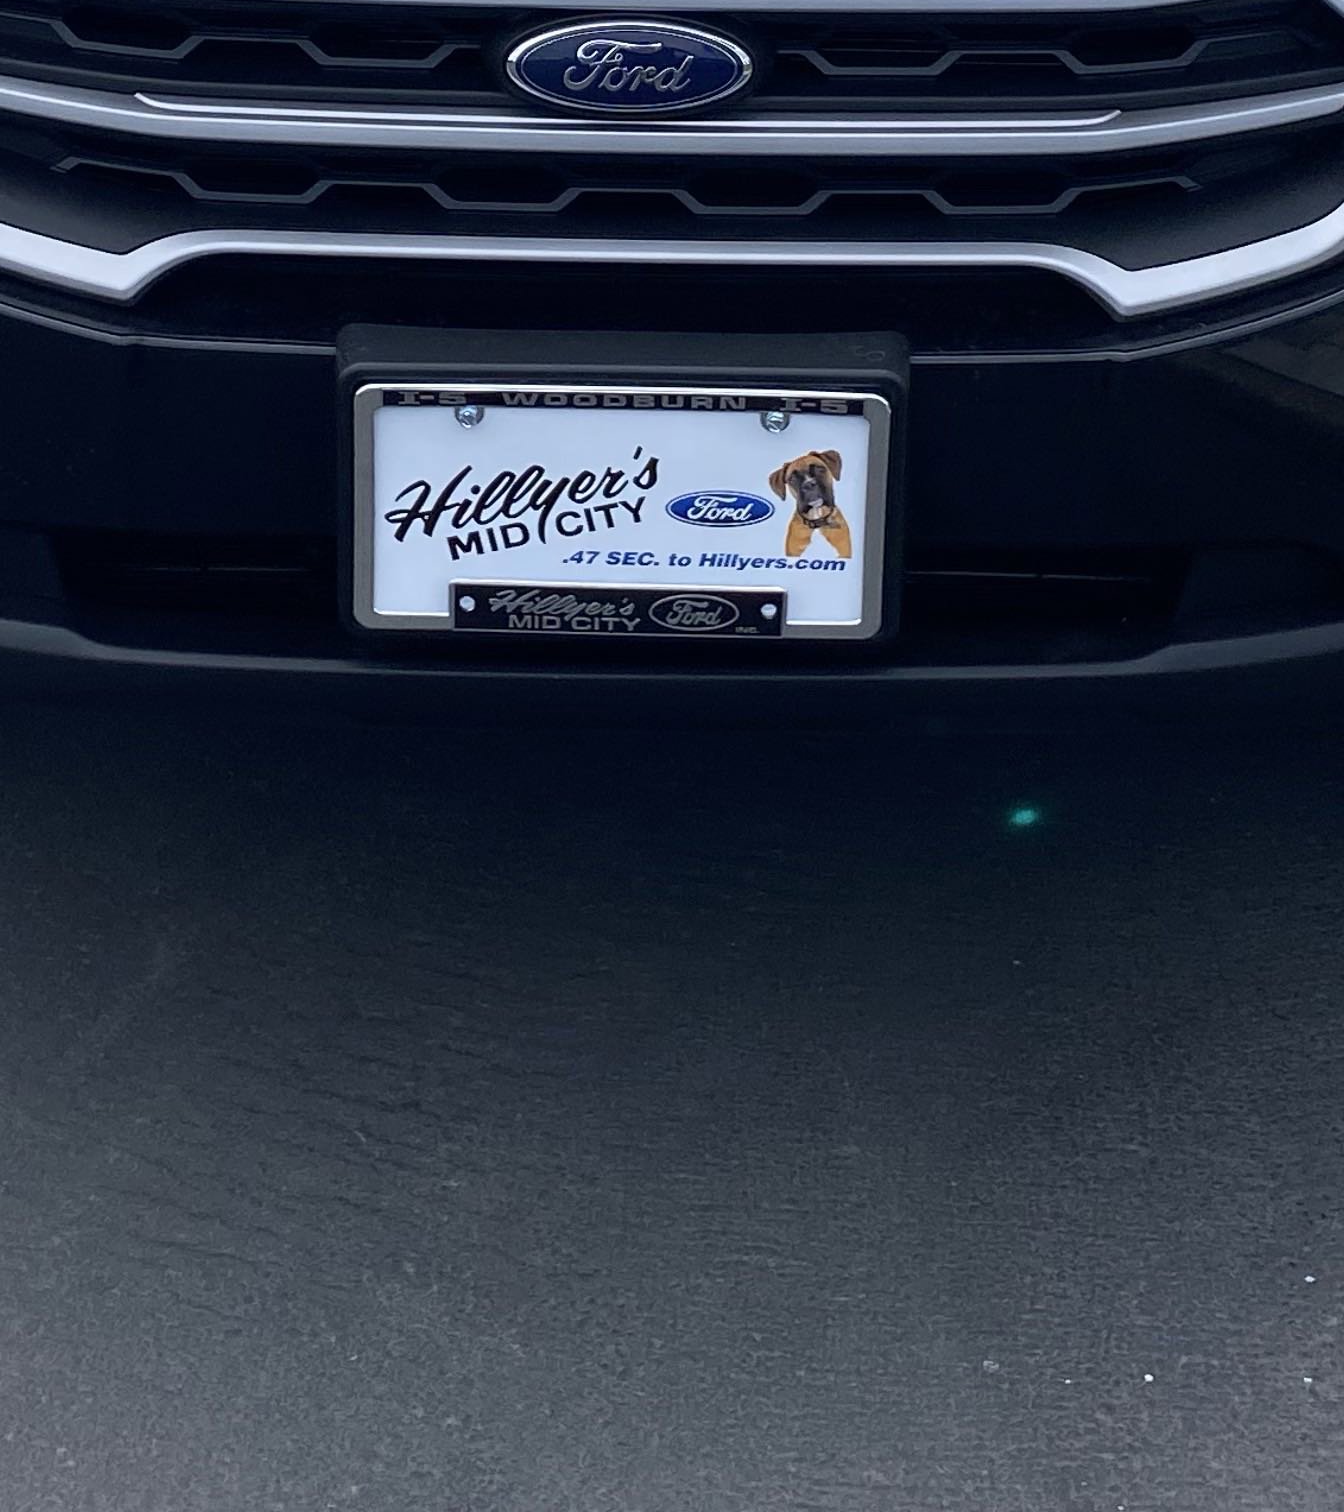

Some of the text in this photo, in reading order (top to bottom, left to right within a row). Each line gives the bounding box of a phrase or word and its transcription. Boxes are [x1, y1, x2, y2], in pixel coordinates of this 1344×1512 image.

[563, 38, 695, 92] Ford
[397, 390, 849, 414] I-5 WOODBURN I-5
[384, 446, 660, 544] Hillyer's
[686, 494, 754, 522] Ford
[447, 495, 646, 561] MID CITY
[562, 550, 847, 571] .47 SEC. to Hillyers.com
[488, 588, 636, 620] Hillyer's
[666, 599, 722, 626] Ford
[507, 614, 641, 632] MID CITY
